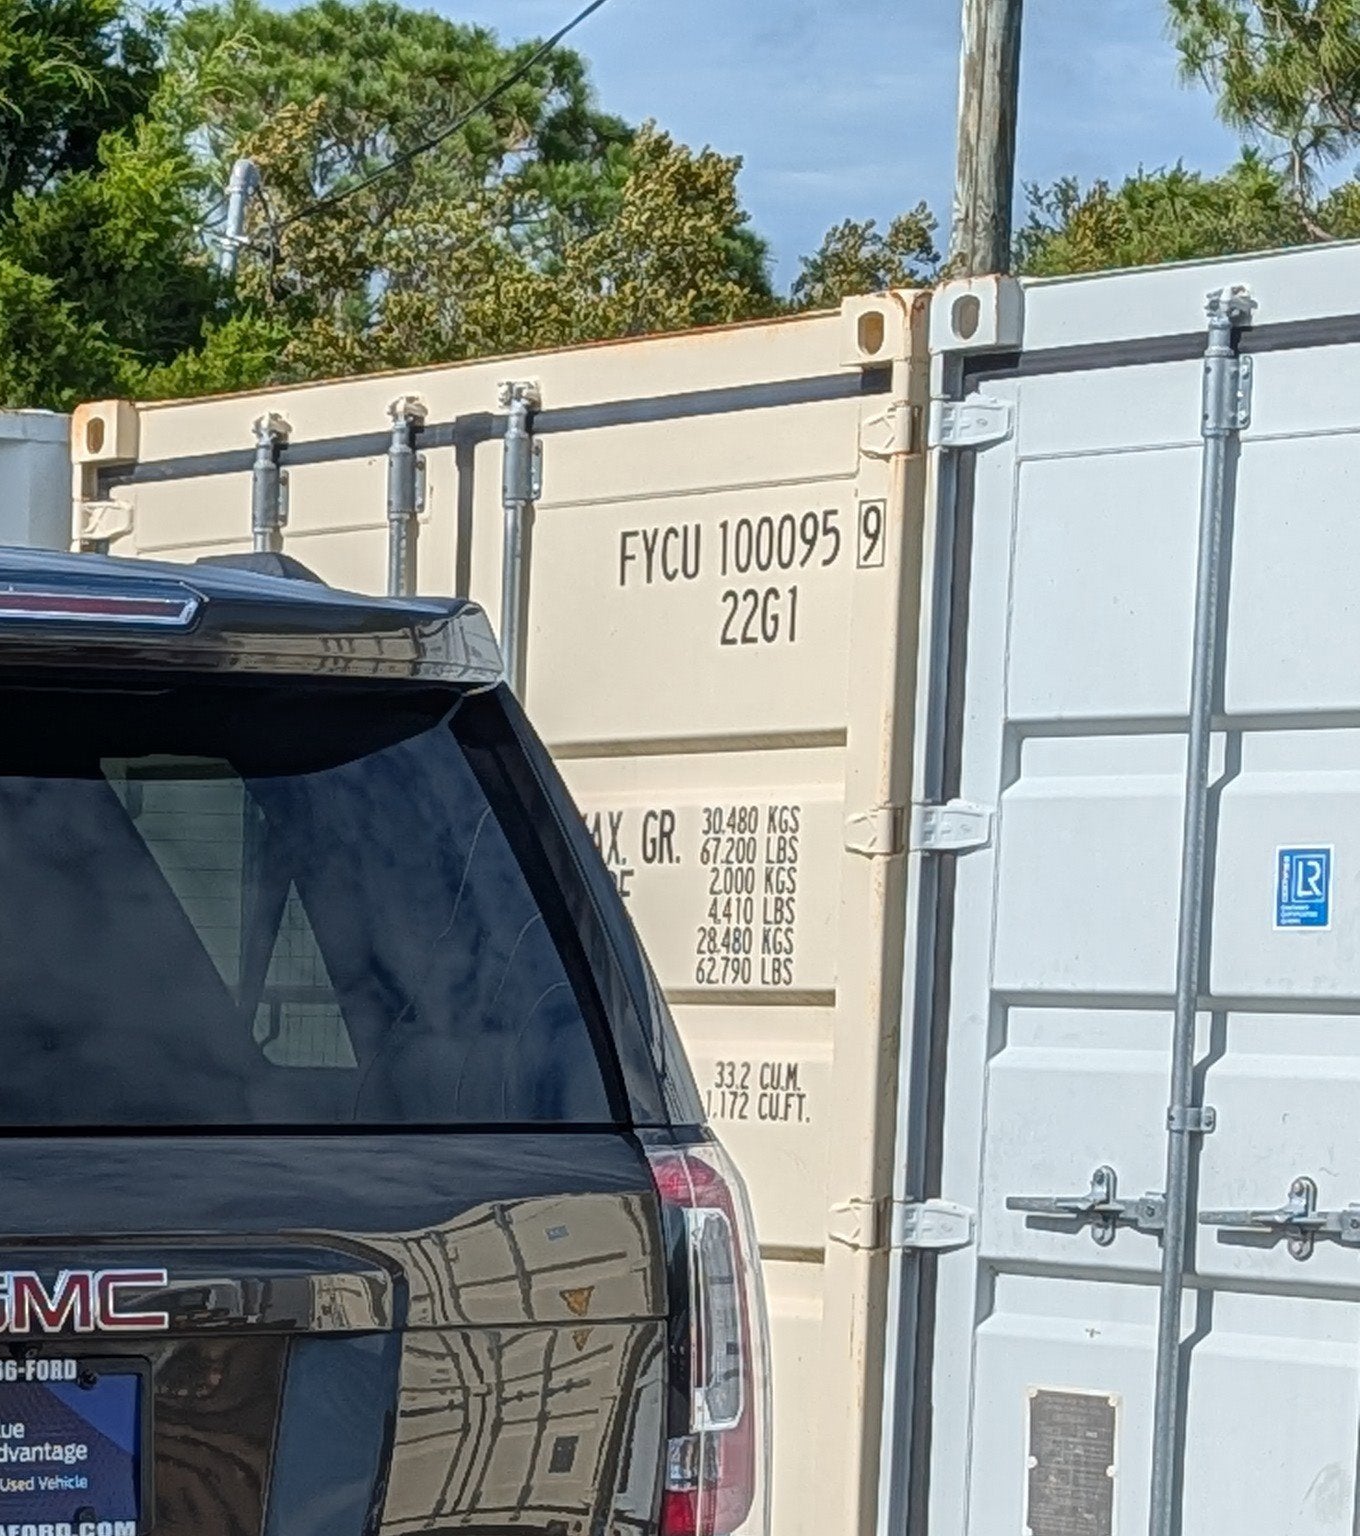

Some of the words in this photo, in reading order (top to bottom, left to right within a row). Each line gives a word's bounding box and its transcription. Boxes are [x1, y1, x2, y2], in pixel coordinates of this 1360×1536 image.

[619, 523, 701, 587] FYCU
[718, 508, 841, 576] 100095
[861, 504, 882, 563] 9
[719, 585, 799, 646] 22G1
[767, 805, 801, 834] KGS
[579, 810, 627, 866] AX.
[642, 809, 681, 864] GR.
[765, 836, 799, 865] LBS
[764, 867, 797, 895] KGS
[1297, 860, 1323, 897] LR
[762, 896, 796, 925] LBS
[761, 926, 794, 955] KGS
[761, 956, 793, 986] LBS
[714, 1061, 751, 1090] 33.2
[760, 1062, 802, 1091] CU.M.
[0, 1476, 35, 1492] Used
[37, 1474, 88, 1490] Vehicle
